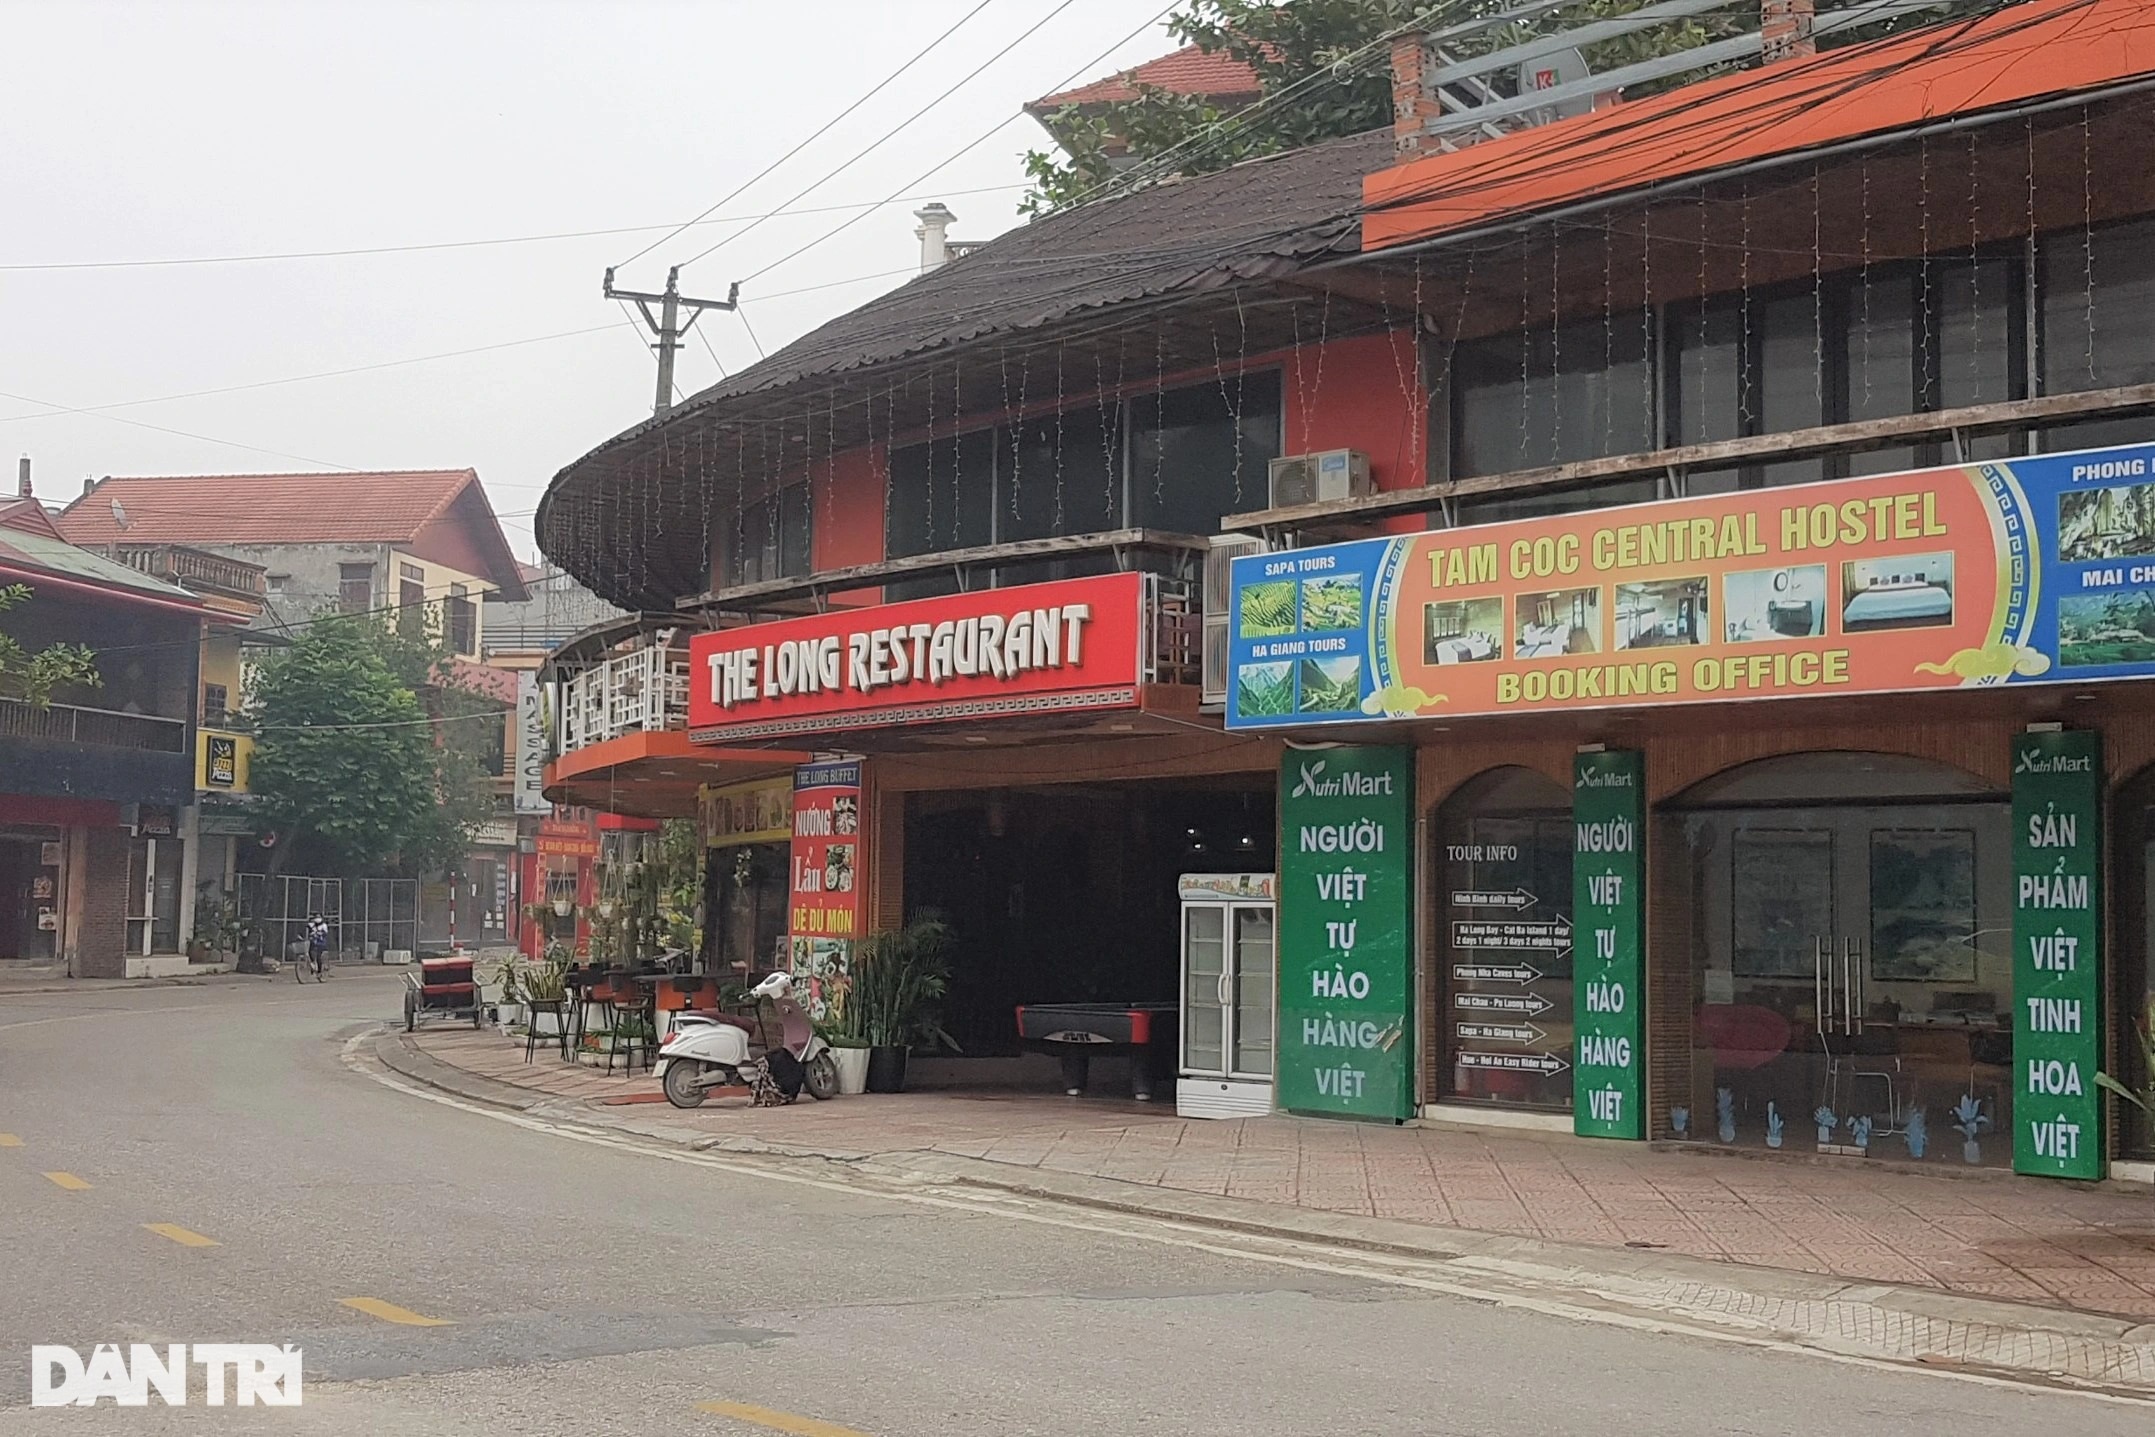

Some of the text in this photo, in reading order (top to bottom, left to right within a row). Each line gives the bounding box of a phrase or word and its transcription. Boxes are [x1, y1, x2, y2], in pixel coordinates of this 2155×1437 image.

[2072, 459, 2145, 482] PHONG
[1428, 491, 1948, 589] TAM COC CENTRAL HOSTEL
[1265, 554, 1336, 577] SAPA TOURS
[2082, 568, 2124, 588] MAI
[707, 603, 1091, 711] THE LONG RESTAURANT
[1252, 637, 1347, 659] HA GIANG TOURS
[1496, 648, 1851, 704] BOOKING OFFICE
[796, 767, 858, 785] THE LONG BUFFET
[795, 801, 831, 837] NƯỚNG
[1300, 816, 1384, 853] NGƯỜI
[1577, 814, 1633, 852] NGƯỜI
[2028, 801, 2076, 848] SẢN
[1446, 845, 1518, 862] TOUR INFO
[1315, 866, 1367, 909] VIỆT
[1588, 868, 1622, 915] VIỆT
[2019, 857, 2089, 910] PHẨM
[826, 904, 853, 933] MÓN
[1326, 918, 1357, 958] TỰ
[1455, 936, 1461, 945] 2
[1525, 937, 1531, 946] 2
[1595, 926, 1616, 968] TỰ
[2030, 927, 2078, 981] VIỆT
[1312, 963, 1370, 1000] HÀO
[1586, 977, 1625, 1013] HÀO
[1302, 1011, 1378, 1049] HÀNG
[2027, 998, 2081, 1034] TINH
[1503, 1057, 1520, 1068] Easy
[1521, 1058, 1540, 1068] Rider
[1541, 1060, 1559, 1069] tours
[1580, 1029, 1631, 1068] HÀNG
[1314, 1062, 1366, 1105] VIỆT
[2028, 1060, 2082, 1097] HOA
[1588, 1084, 1622, 1130] VIỆT
[2031, 1113, 2080, 1168] VIỆT
